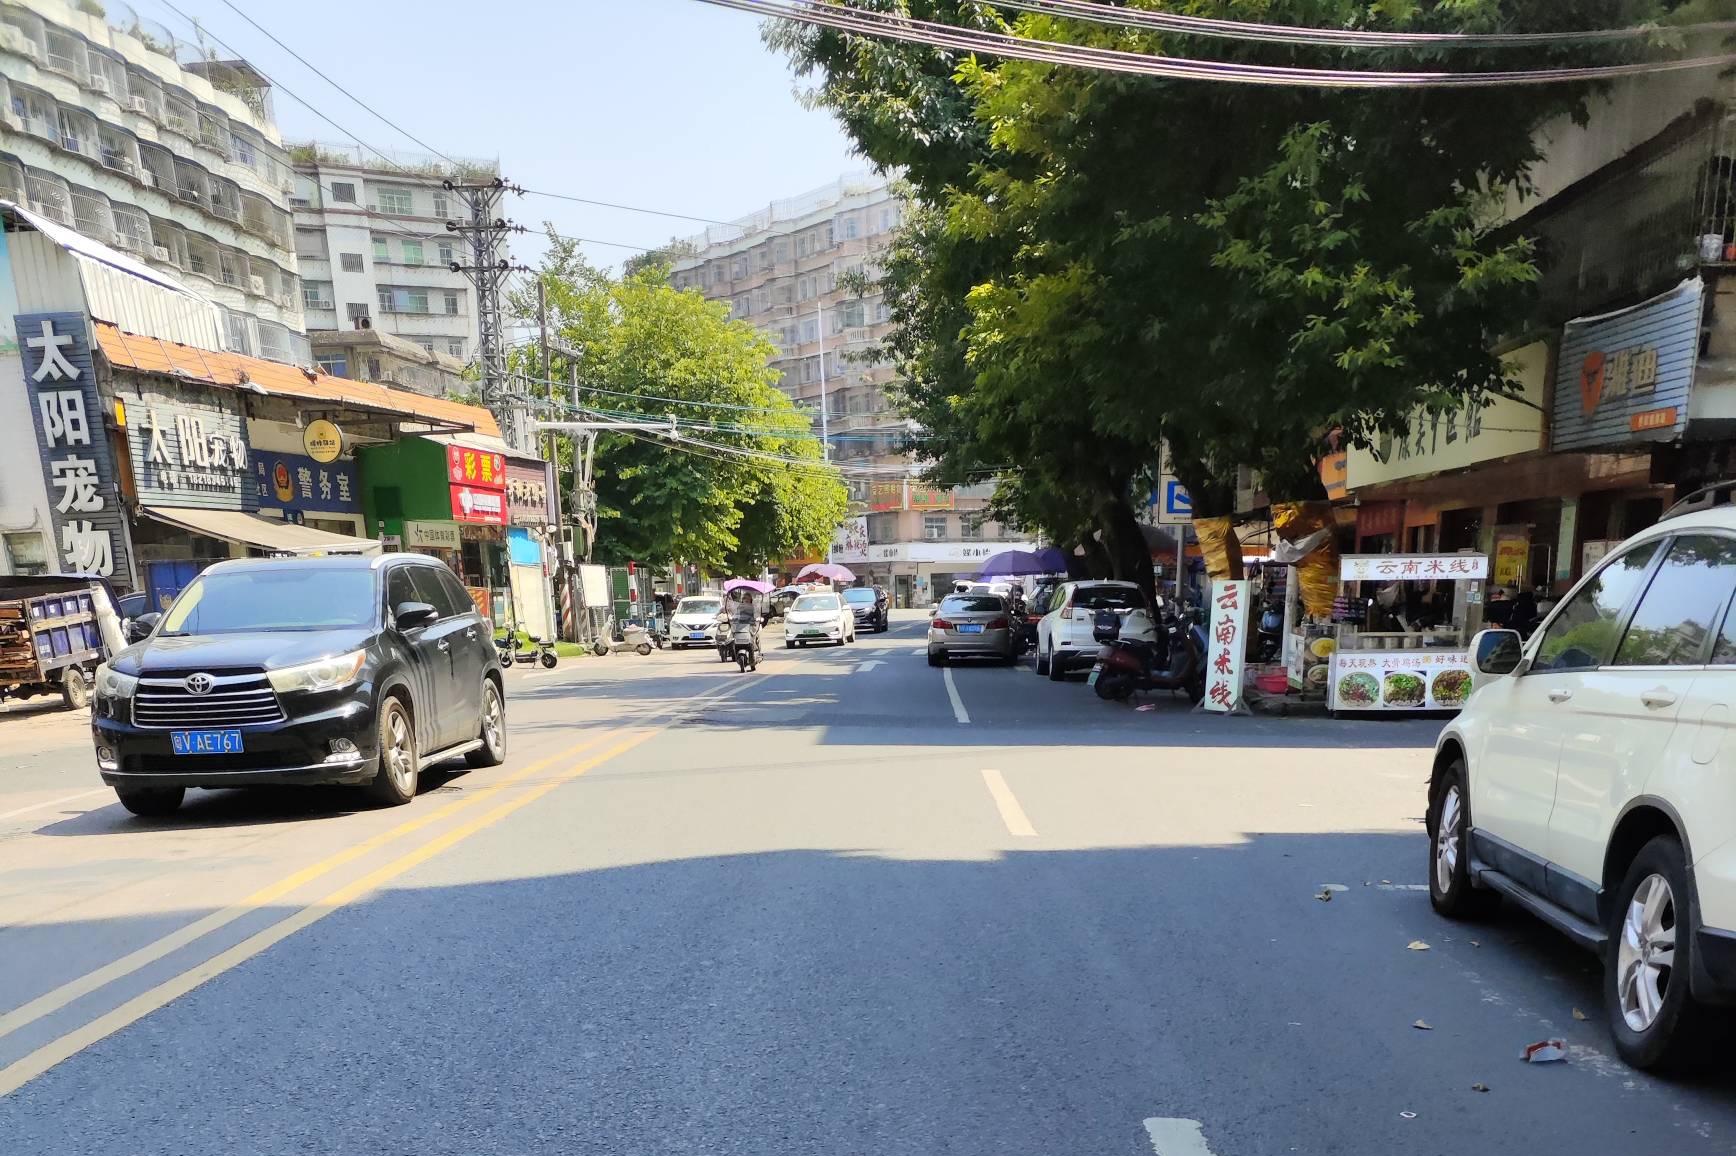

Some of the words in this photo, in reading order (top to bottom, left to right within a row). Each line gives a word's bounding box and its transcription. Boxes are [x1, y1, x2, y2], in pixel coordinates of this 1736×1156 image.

[27, 320, 114, 577] 太阳宠物
[139, 409, 248, 471] 太阳宠物
[297, 466, 352, 502] 警务室
[464, 452, 493, 482] 彩票
[1376, 559, 1470, 575] 云南米线
[1209, 583, 1240, 709] 云南米线
